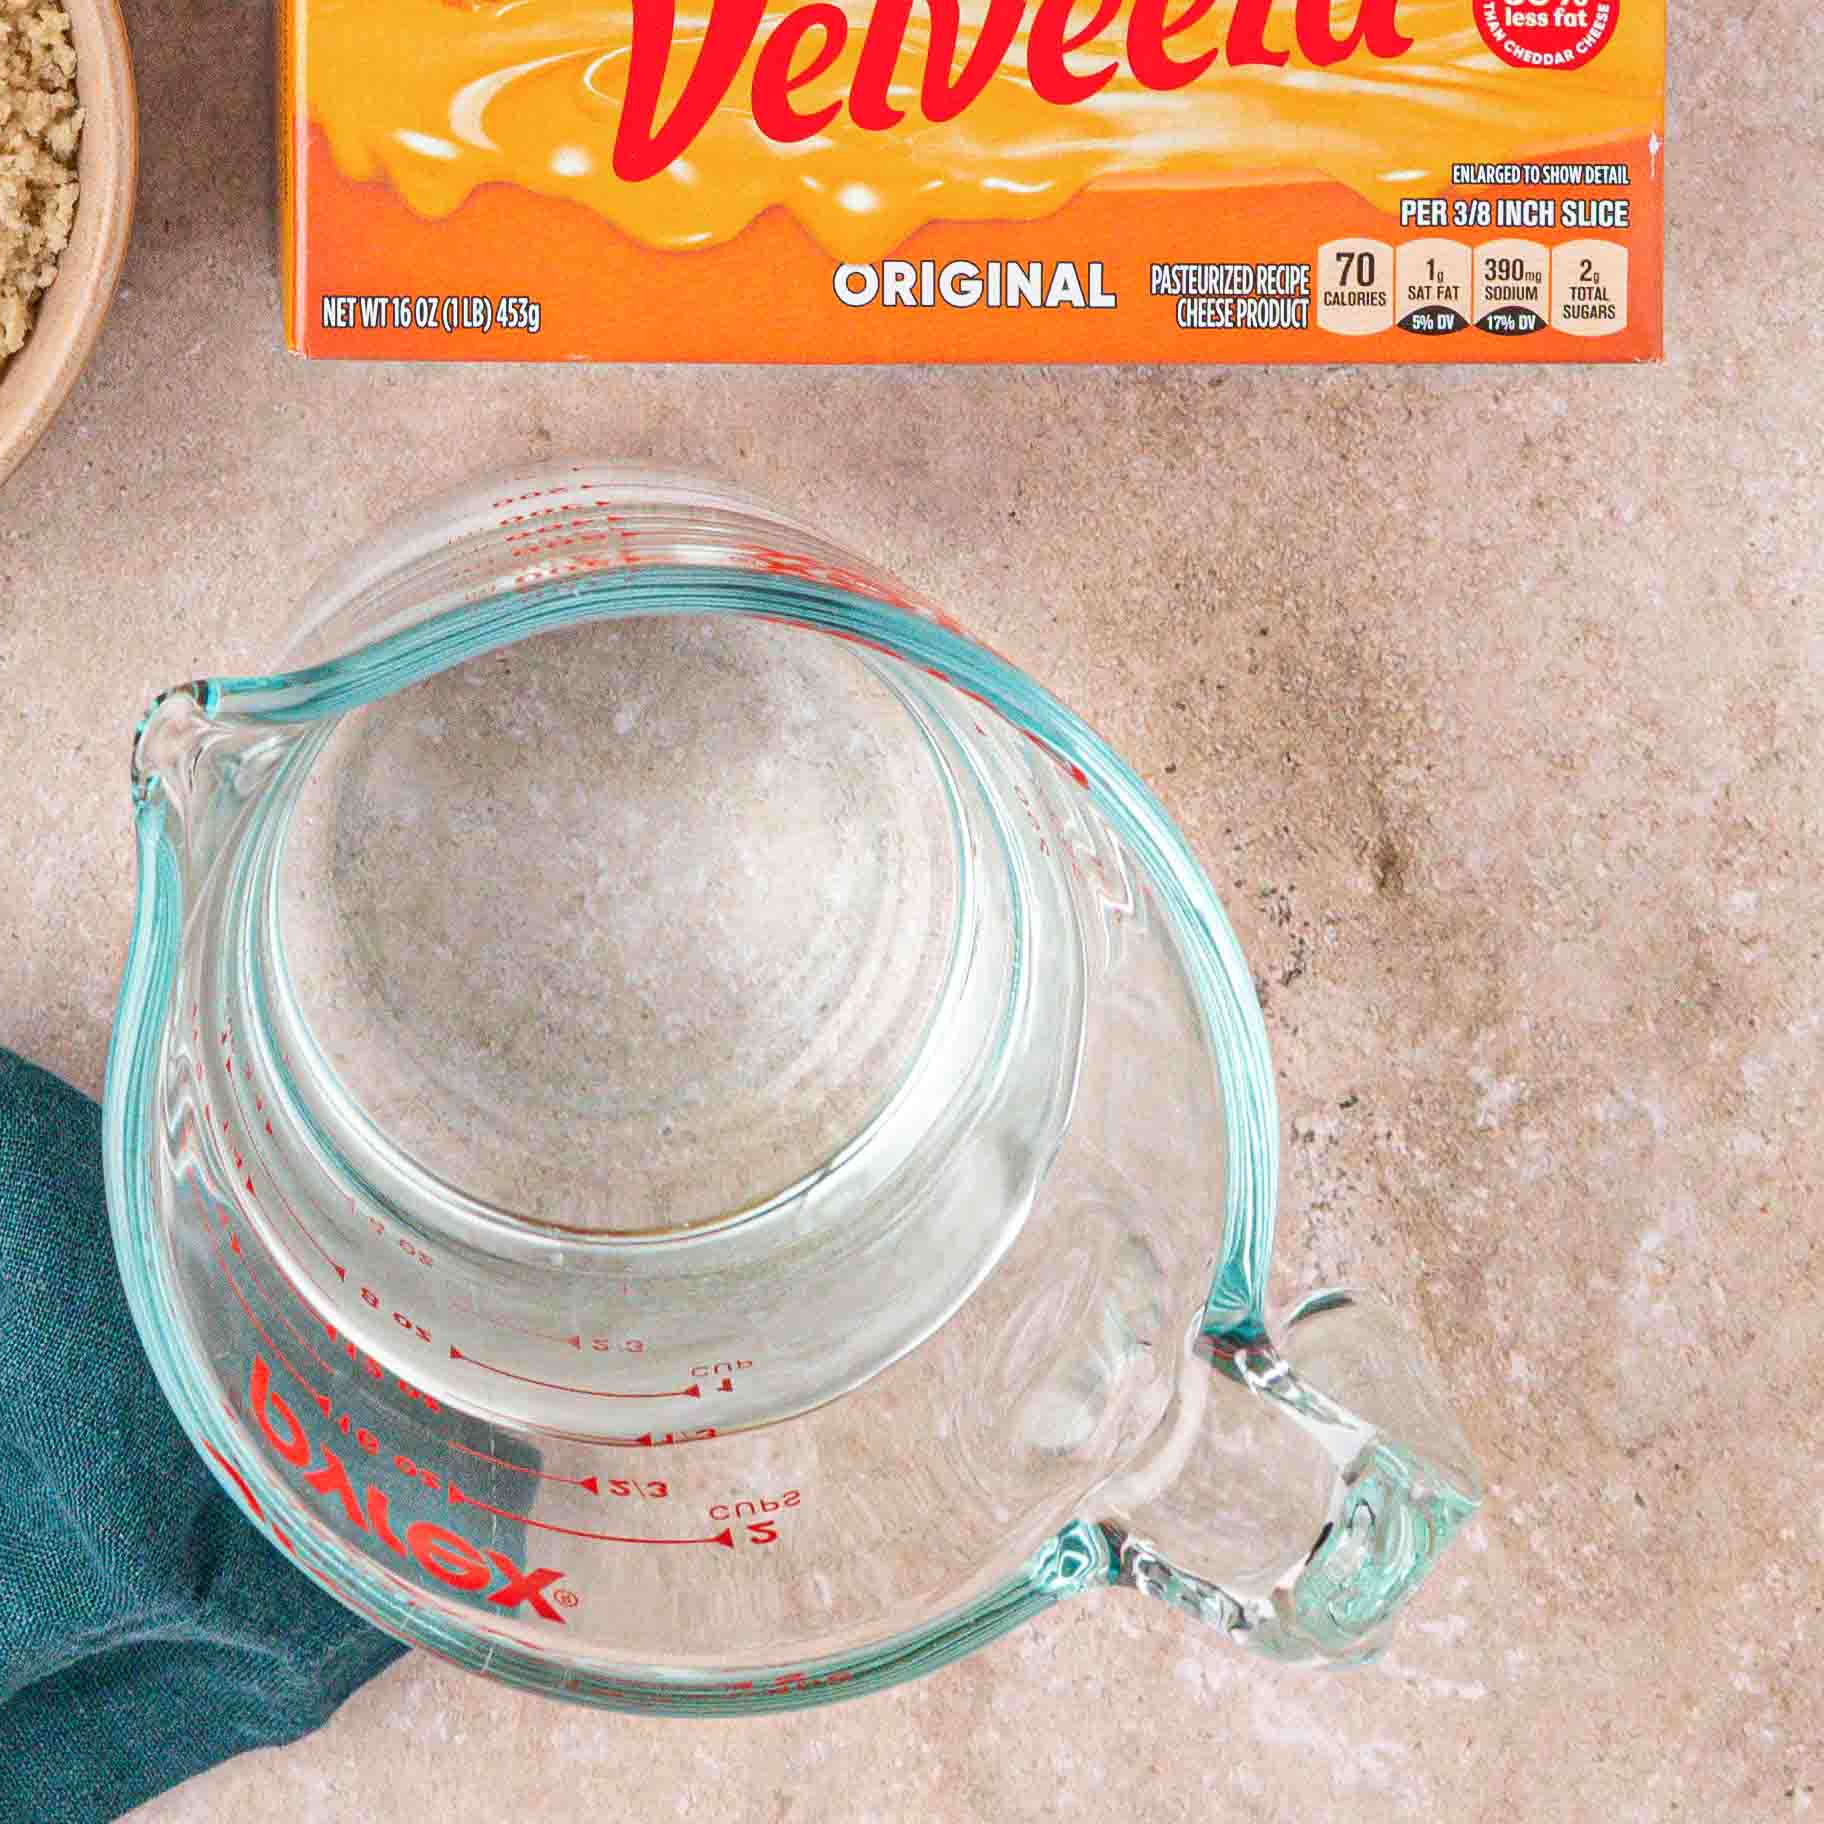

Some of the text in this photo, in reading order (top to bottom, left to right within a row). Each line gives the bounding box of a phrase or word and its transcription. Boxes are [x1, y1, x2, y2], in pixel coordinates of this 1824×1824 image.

[1505, 7, 1588, 27] less fat
[1483, 1, 1611, 65] THAN CHEDDAR CHEESE
[1452, 163, 1630, 184] ENLARGED SHOW DETAIL
[1400, 199, 1630, 227] PER 3/8 INCH SLICE
[1150, 263, 1311, 296] PASTEURIZED RECIPE
[1335, 252, 1375, 287] 70
[833, 260, 1117, 309] ORIGINAL
[1407, 285, 1460, 301] SAT FAT
[1485, 286, 1538, 301] SODIUM
[1569, 287, 1609, 301] TOTAL
[1323, 291, 1386, 306] CALORIES
[323, 297, 541, 333] NET WT 16 OZ 453g
[1176, 297, 1310, 329] CHEESE PRODUCT
[1563, 304, 1616, 320] SUGARS
[1412, 314, 1434, 331] 5%
[1488, 314, 1536, 331] 17% DV
